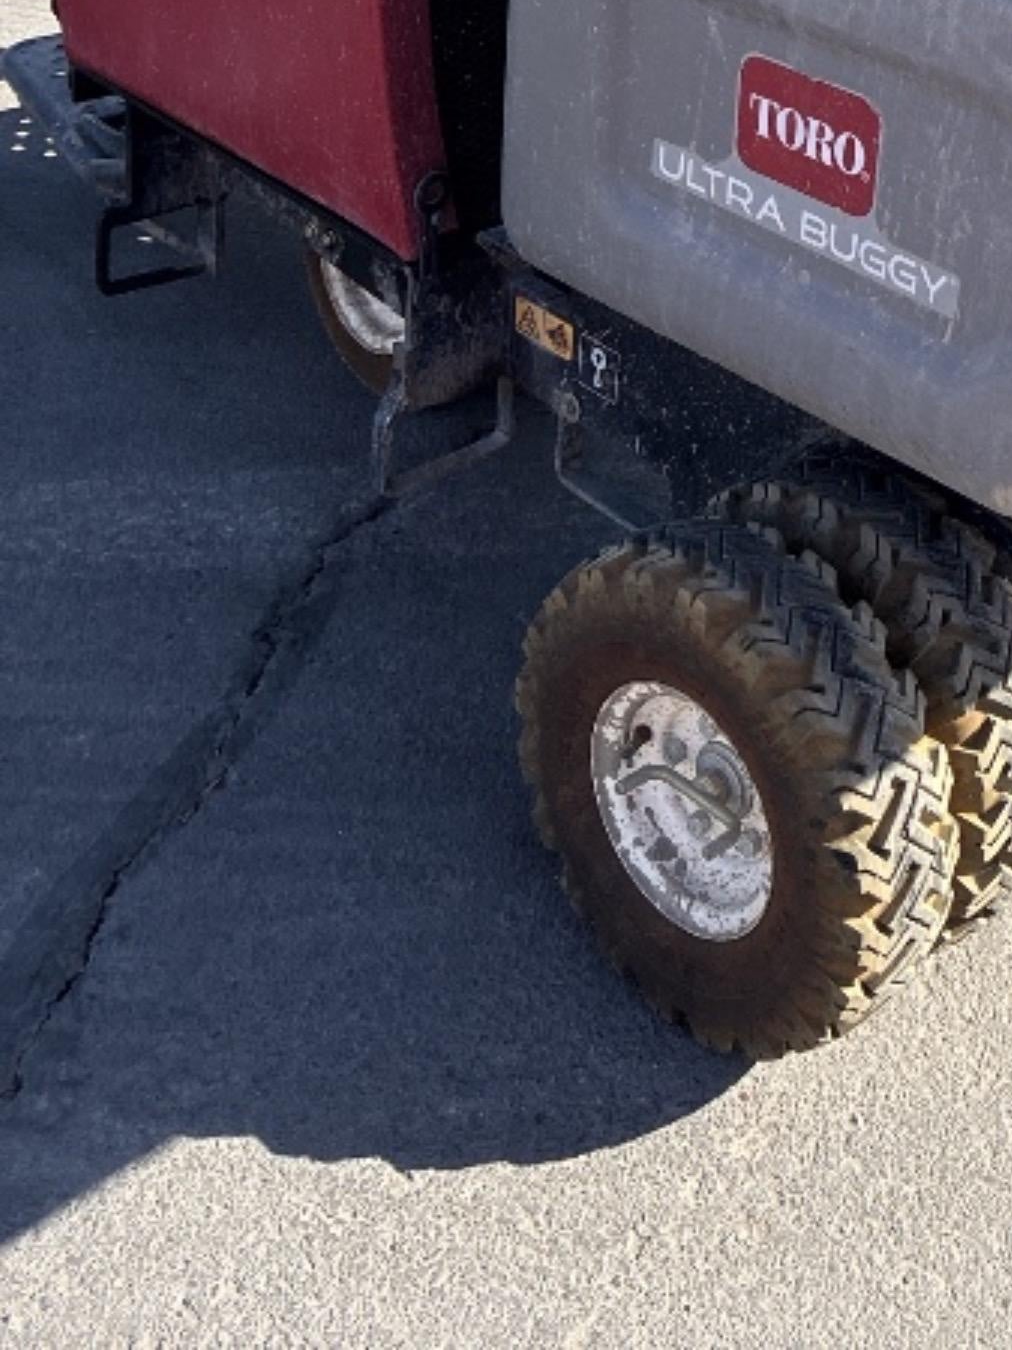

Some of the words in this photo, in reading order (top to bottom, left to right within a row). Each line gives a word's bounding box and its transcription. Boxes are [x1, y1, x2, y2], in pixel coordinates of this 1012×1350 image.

[749, 93, 866, 176] TORO
[657, 144, 786, 232] ULTRA
[799, 211, 948, 305] BUGGY
